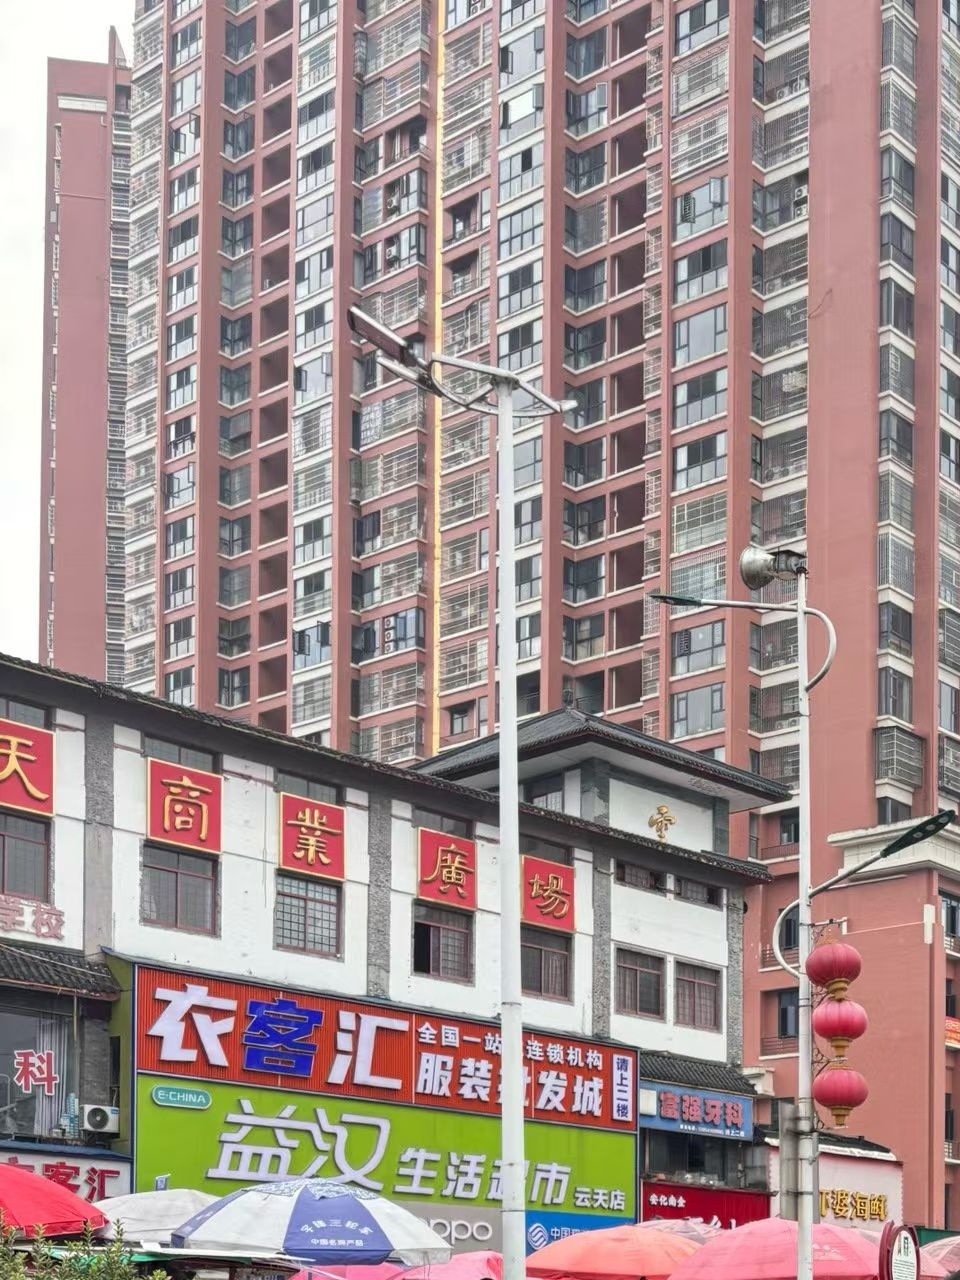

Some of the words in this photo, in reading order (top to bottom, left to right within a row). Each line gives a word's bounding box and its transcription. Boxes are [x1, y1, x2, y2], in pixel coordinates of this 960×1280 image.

[147, 983, 409, 1090] 衣客汇
[417, 1021, 603, 1071] 全国一站连锁机构
[14, 1050, 58, 1095] 科
[616, 1057, 629, 1118] 请上二楼
[157, 1089, 206, 1105] E-CHINA
[660, 1092, 742, 1128] 富强牙科
[8, 1156, 120, 1203] 客汇
[574, 1186, 626, 1212] 云天店
[420, 1217, 492, 1244] ppo
